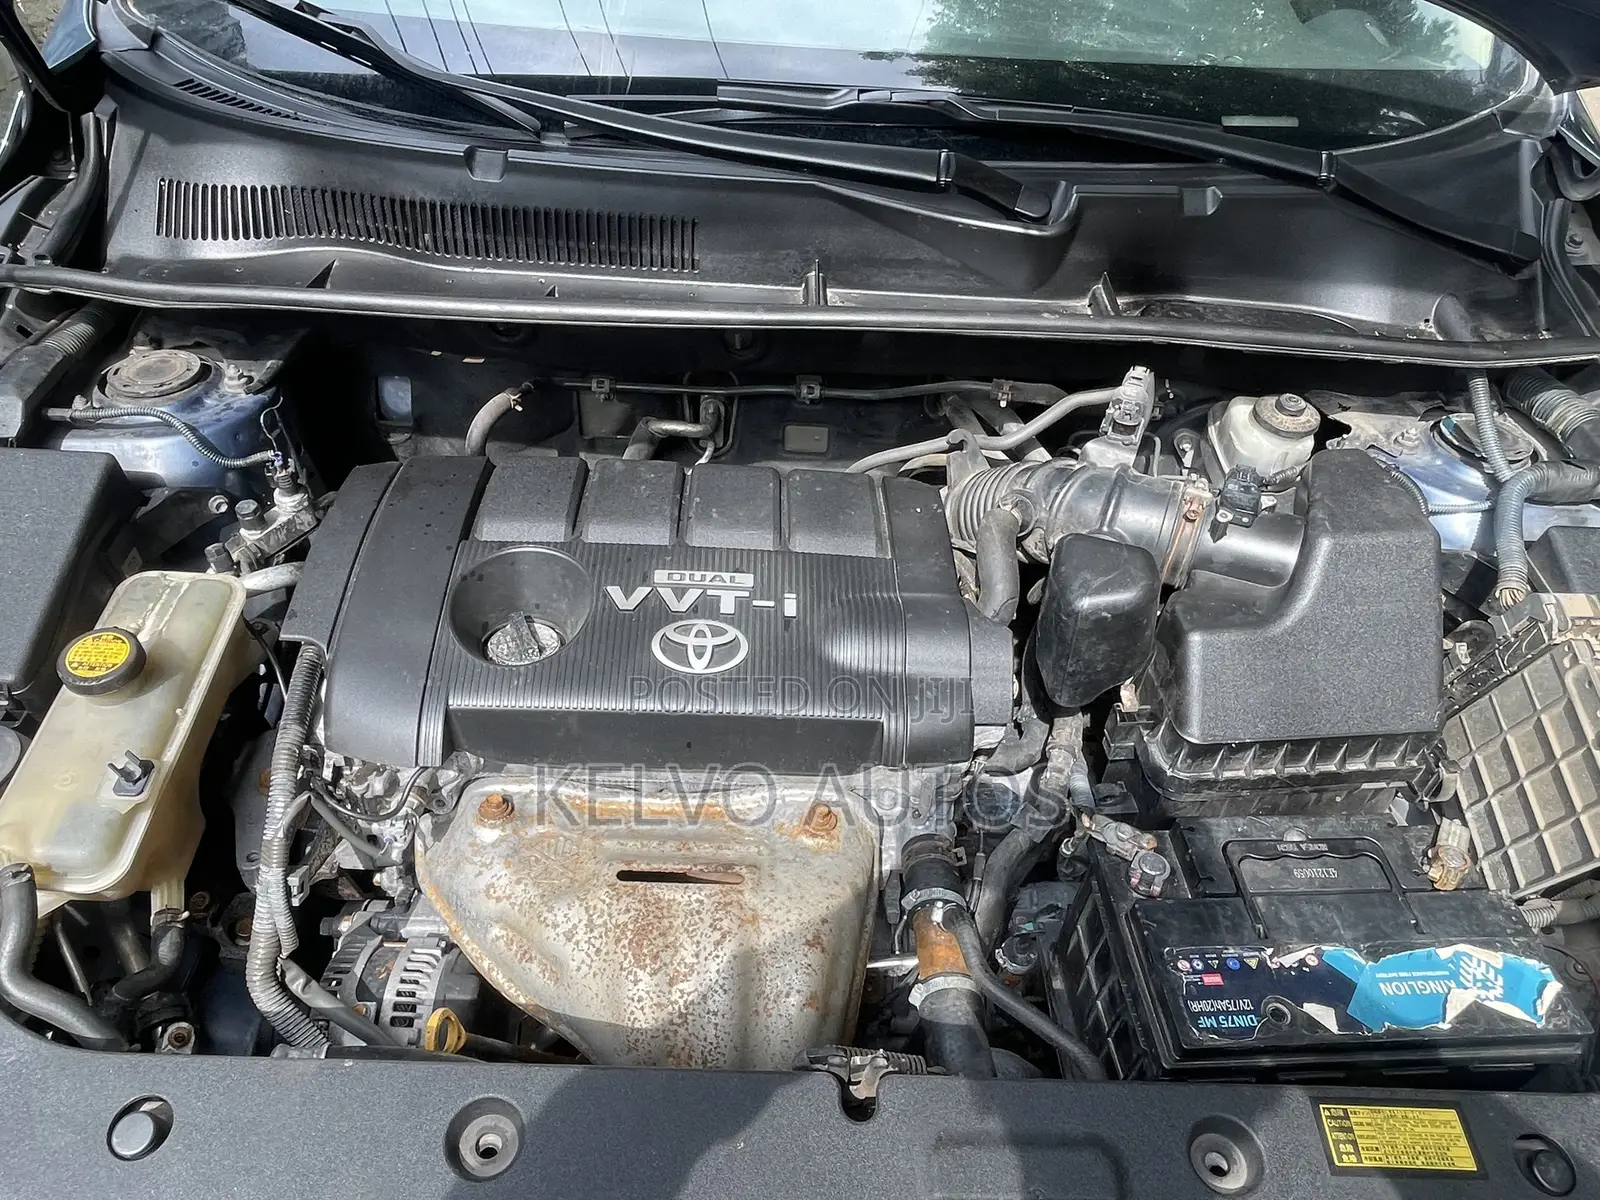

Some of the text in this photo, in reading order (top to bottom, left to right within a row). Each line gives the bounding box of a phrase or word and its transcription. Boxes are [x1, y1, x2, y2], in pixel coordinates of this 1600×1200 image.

[667, 572, 745, 585] DUAL
[604, 585, 797, 618] VVT-i
[1198, 1014, 1258, 1028] DIN75 MF
